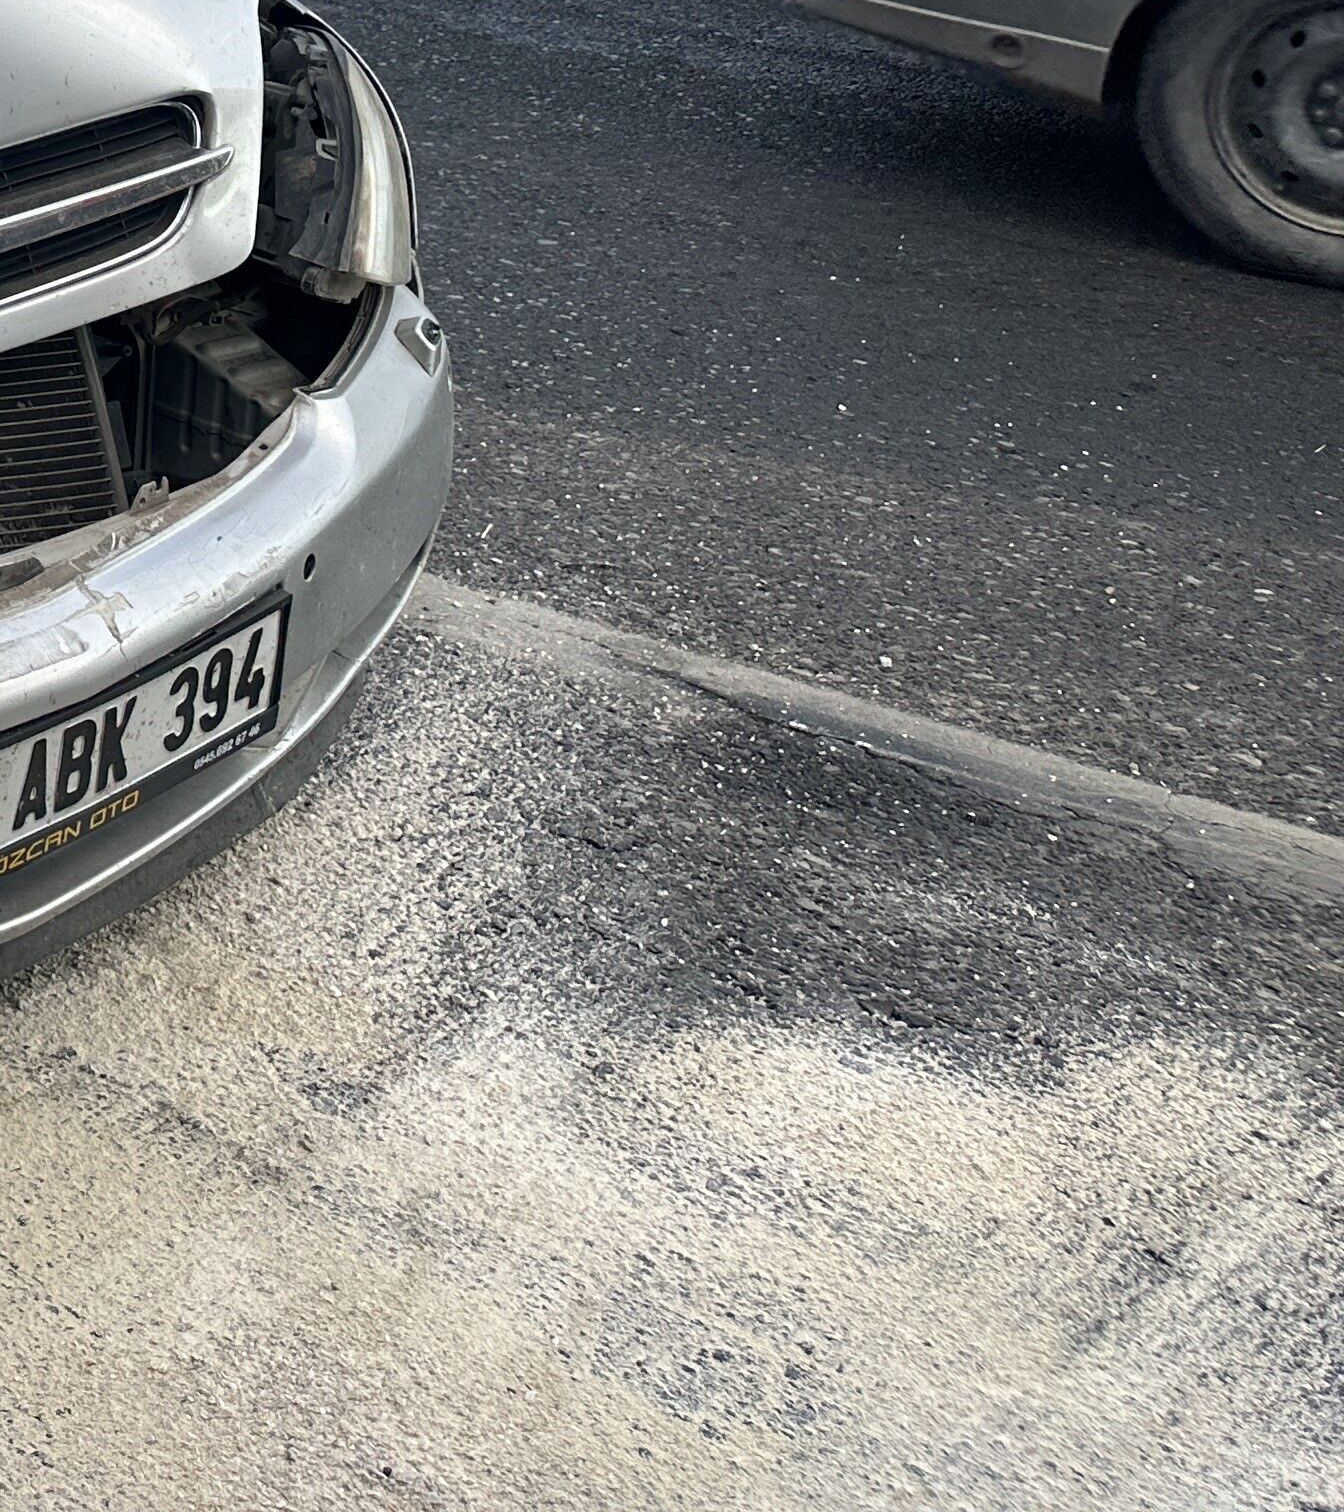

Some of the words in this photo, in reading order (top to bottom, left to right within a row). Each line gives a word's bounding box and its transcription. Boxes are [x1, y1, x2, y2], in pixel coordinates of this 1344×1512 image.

[12, 695, 138, 831] ABK
[163, 627, 266, 752] 394
[89, 789, 140, 830] OTO
